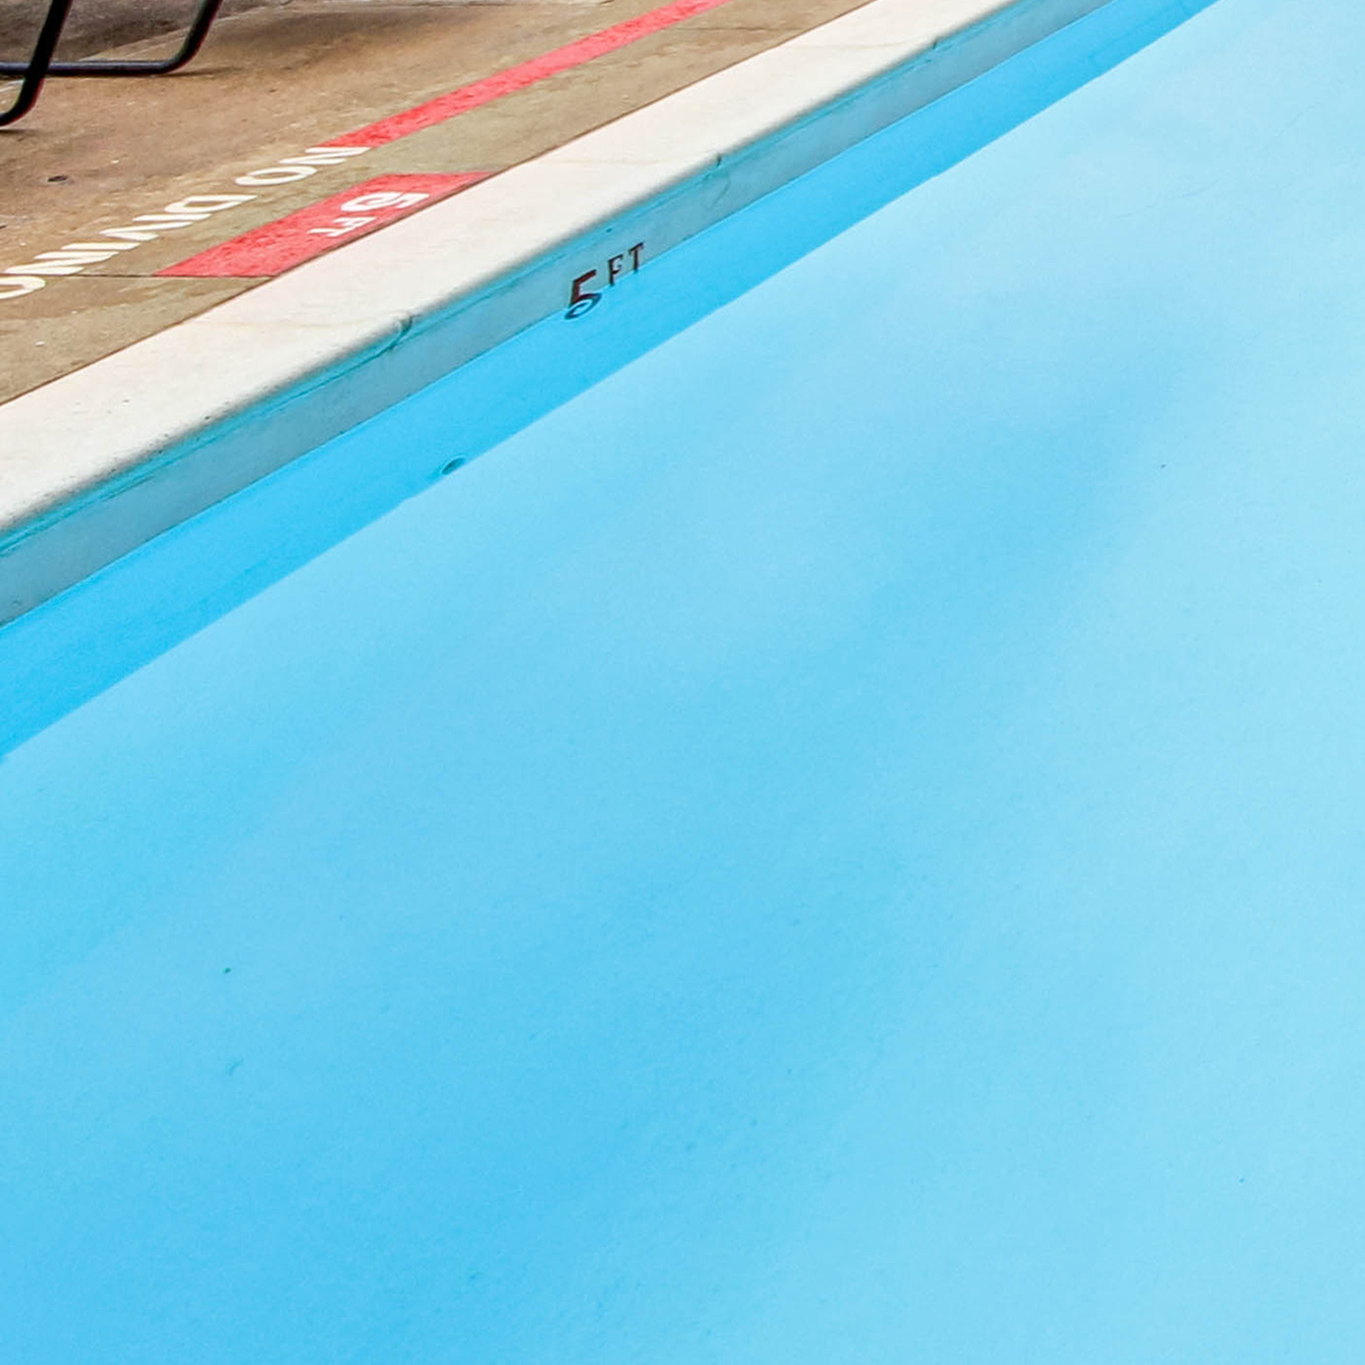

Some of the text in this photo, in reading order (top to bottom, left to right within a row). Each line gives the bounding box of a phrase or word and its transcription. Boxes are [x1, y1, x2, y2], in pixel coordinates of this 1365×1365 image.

[234, 147, 371, 186] NO
[307, 216, 376, 238] FT
[564, 242, 644, 320] 5 FT
